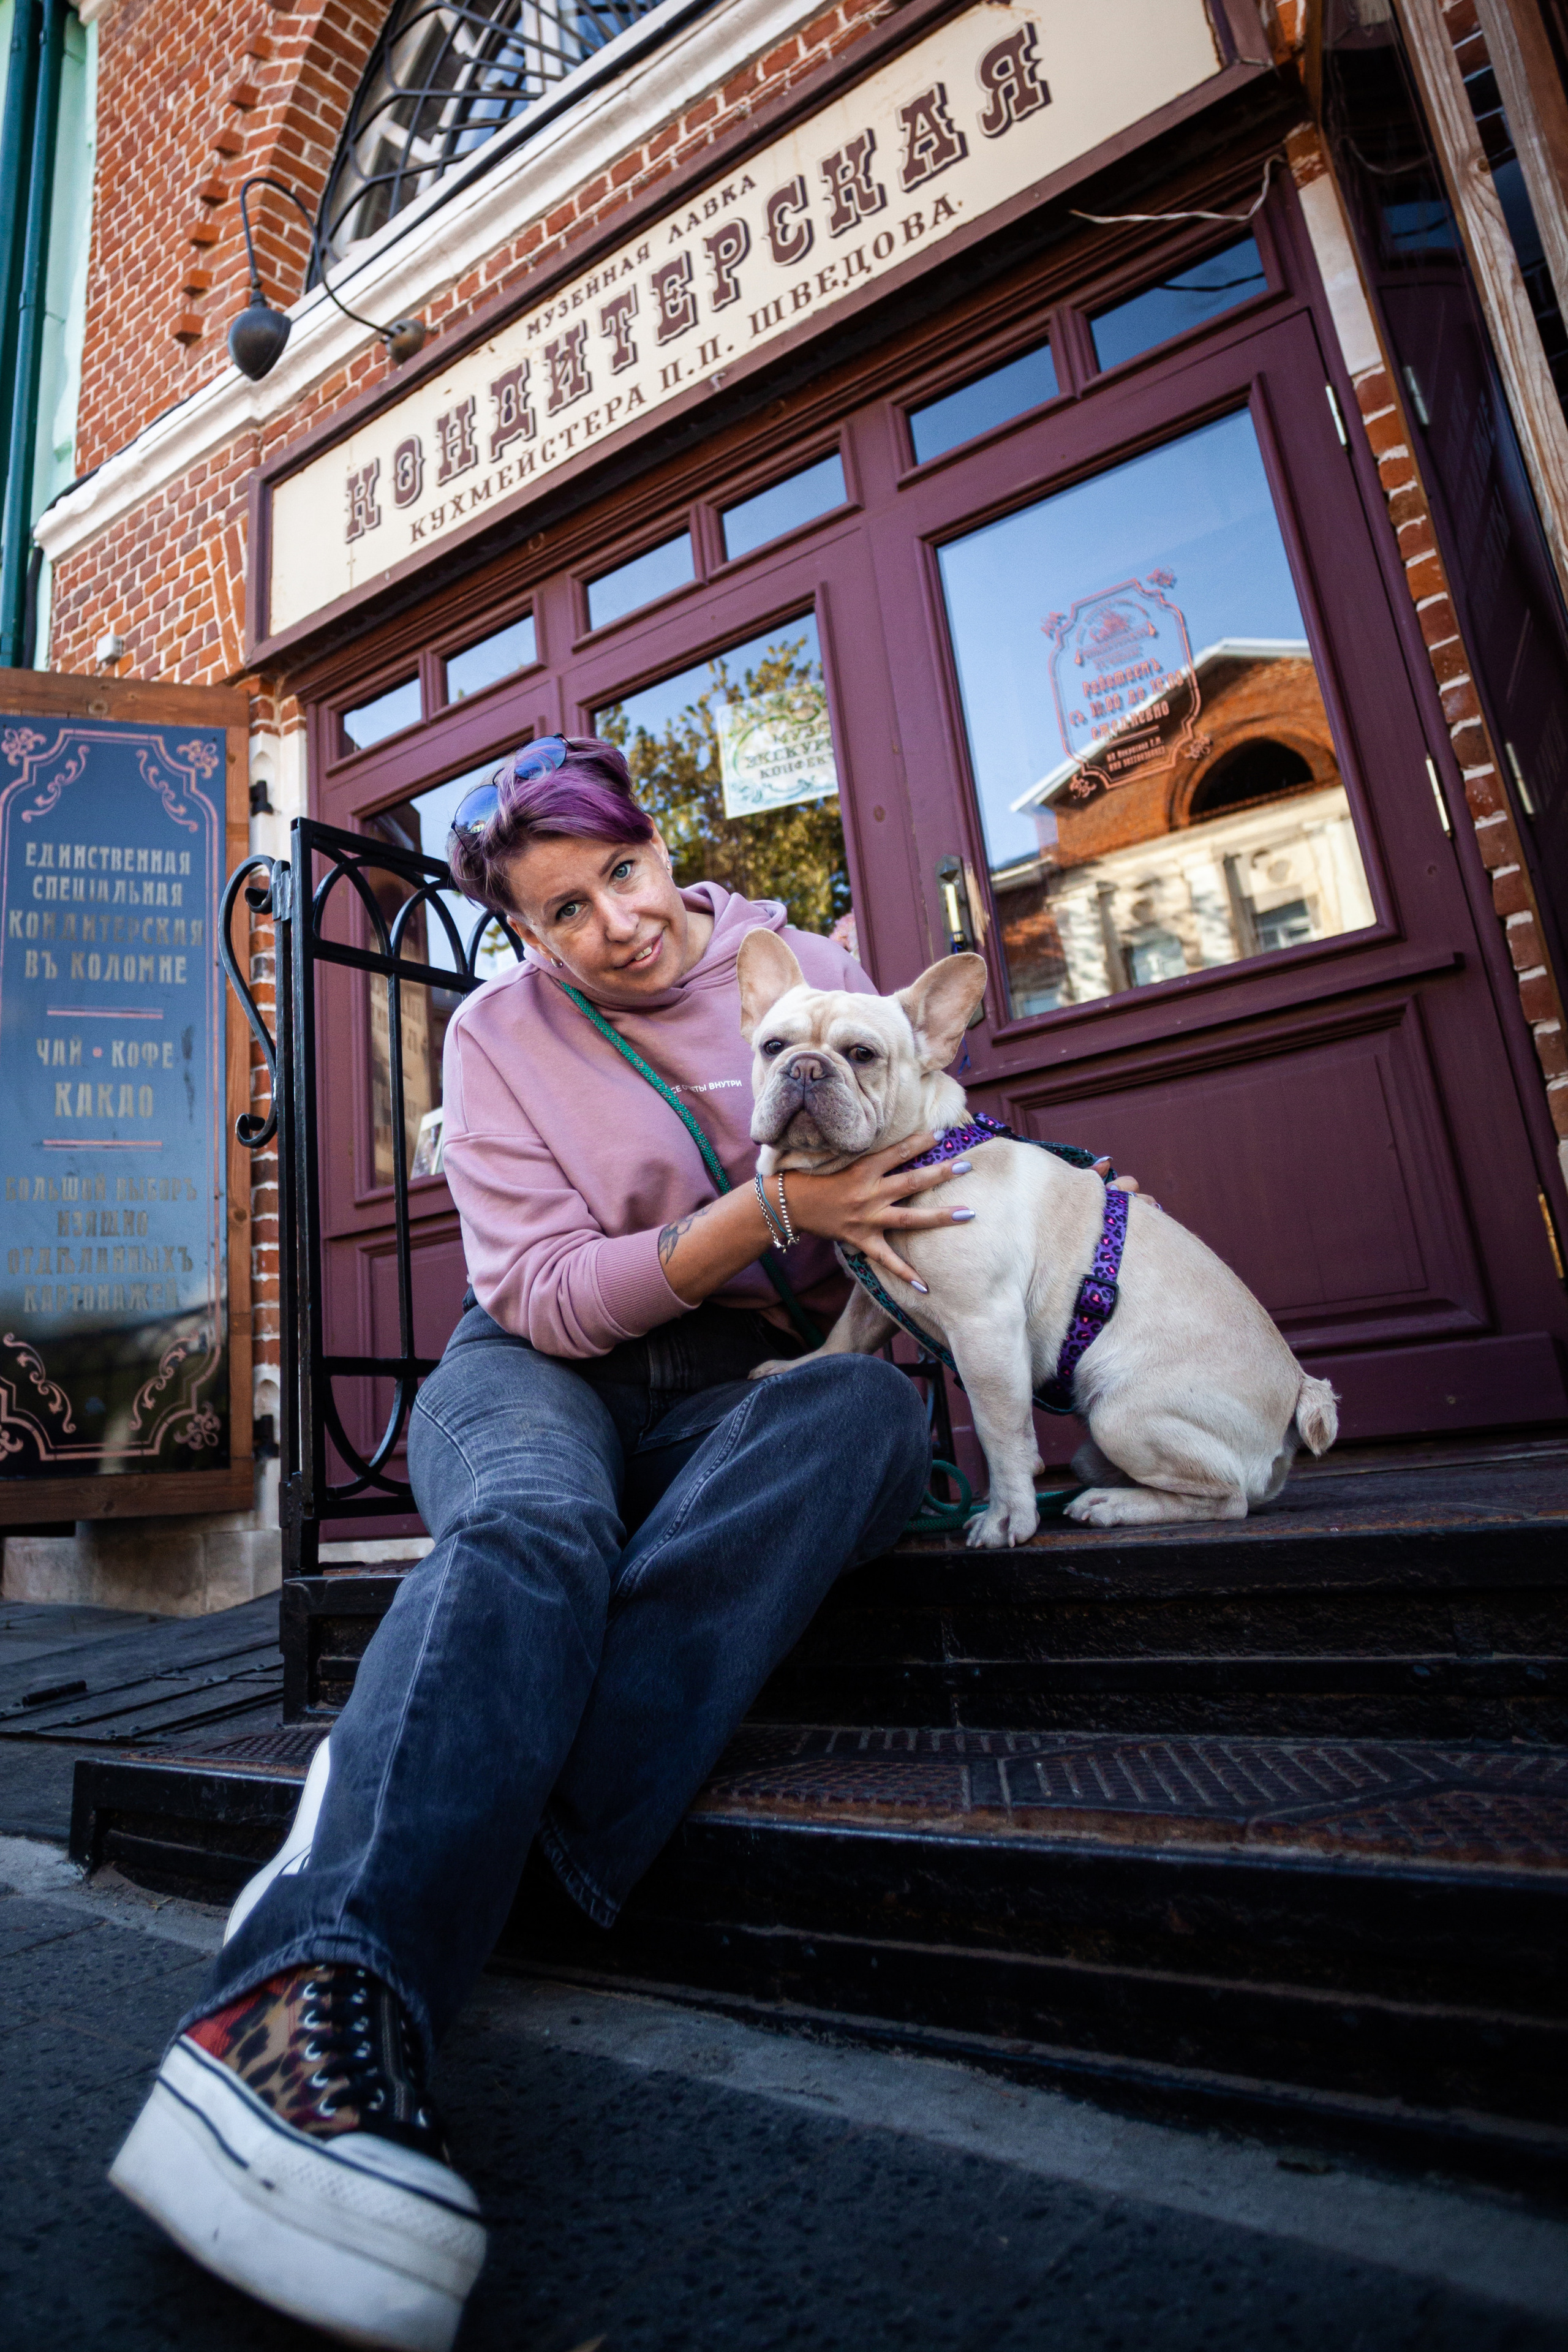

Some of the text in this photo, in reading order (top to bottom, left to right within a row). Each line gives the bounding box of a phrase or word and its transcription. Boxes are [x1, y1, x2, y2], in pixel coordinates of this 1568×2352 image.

[527, 175, 757, 339] МУЗЕЙНАЯ ЛАВКА
[345, 22, 1052, 543] КОНДИТЕРСКАЯ
[410, 384, 646, 545] КУХМЕЙСТЕРА
[25, 842, 191, 875] ЕДИНСТВЕННАЯ
[8, 910, 204, 946] КОНДИТЕРСКАЯ
[24, 949, 187, 984] ВЪ КОЛОМНЕ
[36, 1035, 174, 1069] ЧАЙ КОФЕ
[54, 1081, 154, 1118] КАКАО
[709, 1080, 742, 1090] ВНУТРИ
[5, 1174, 198, 1202] БОЛЬШОЙ ВЫБОРЪ
[57, 1210, 148, 1237] ИЗЯЩНО
[23, 1278, 181, 1313] КАРТОНАЖЕЙ
